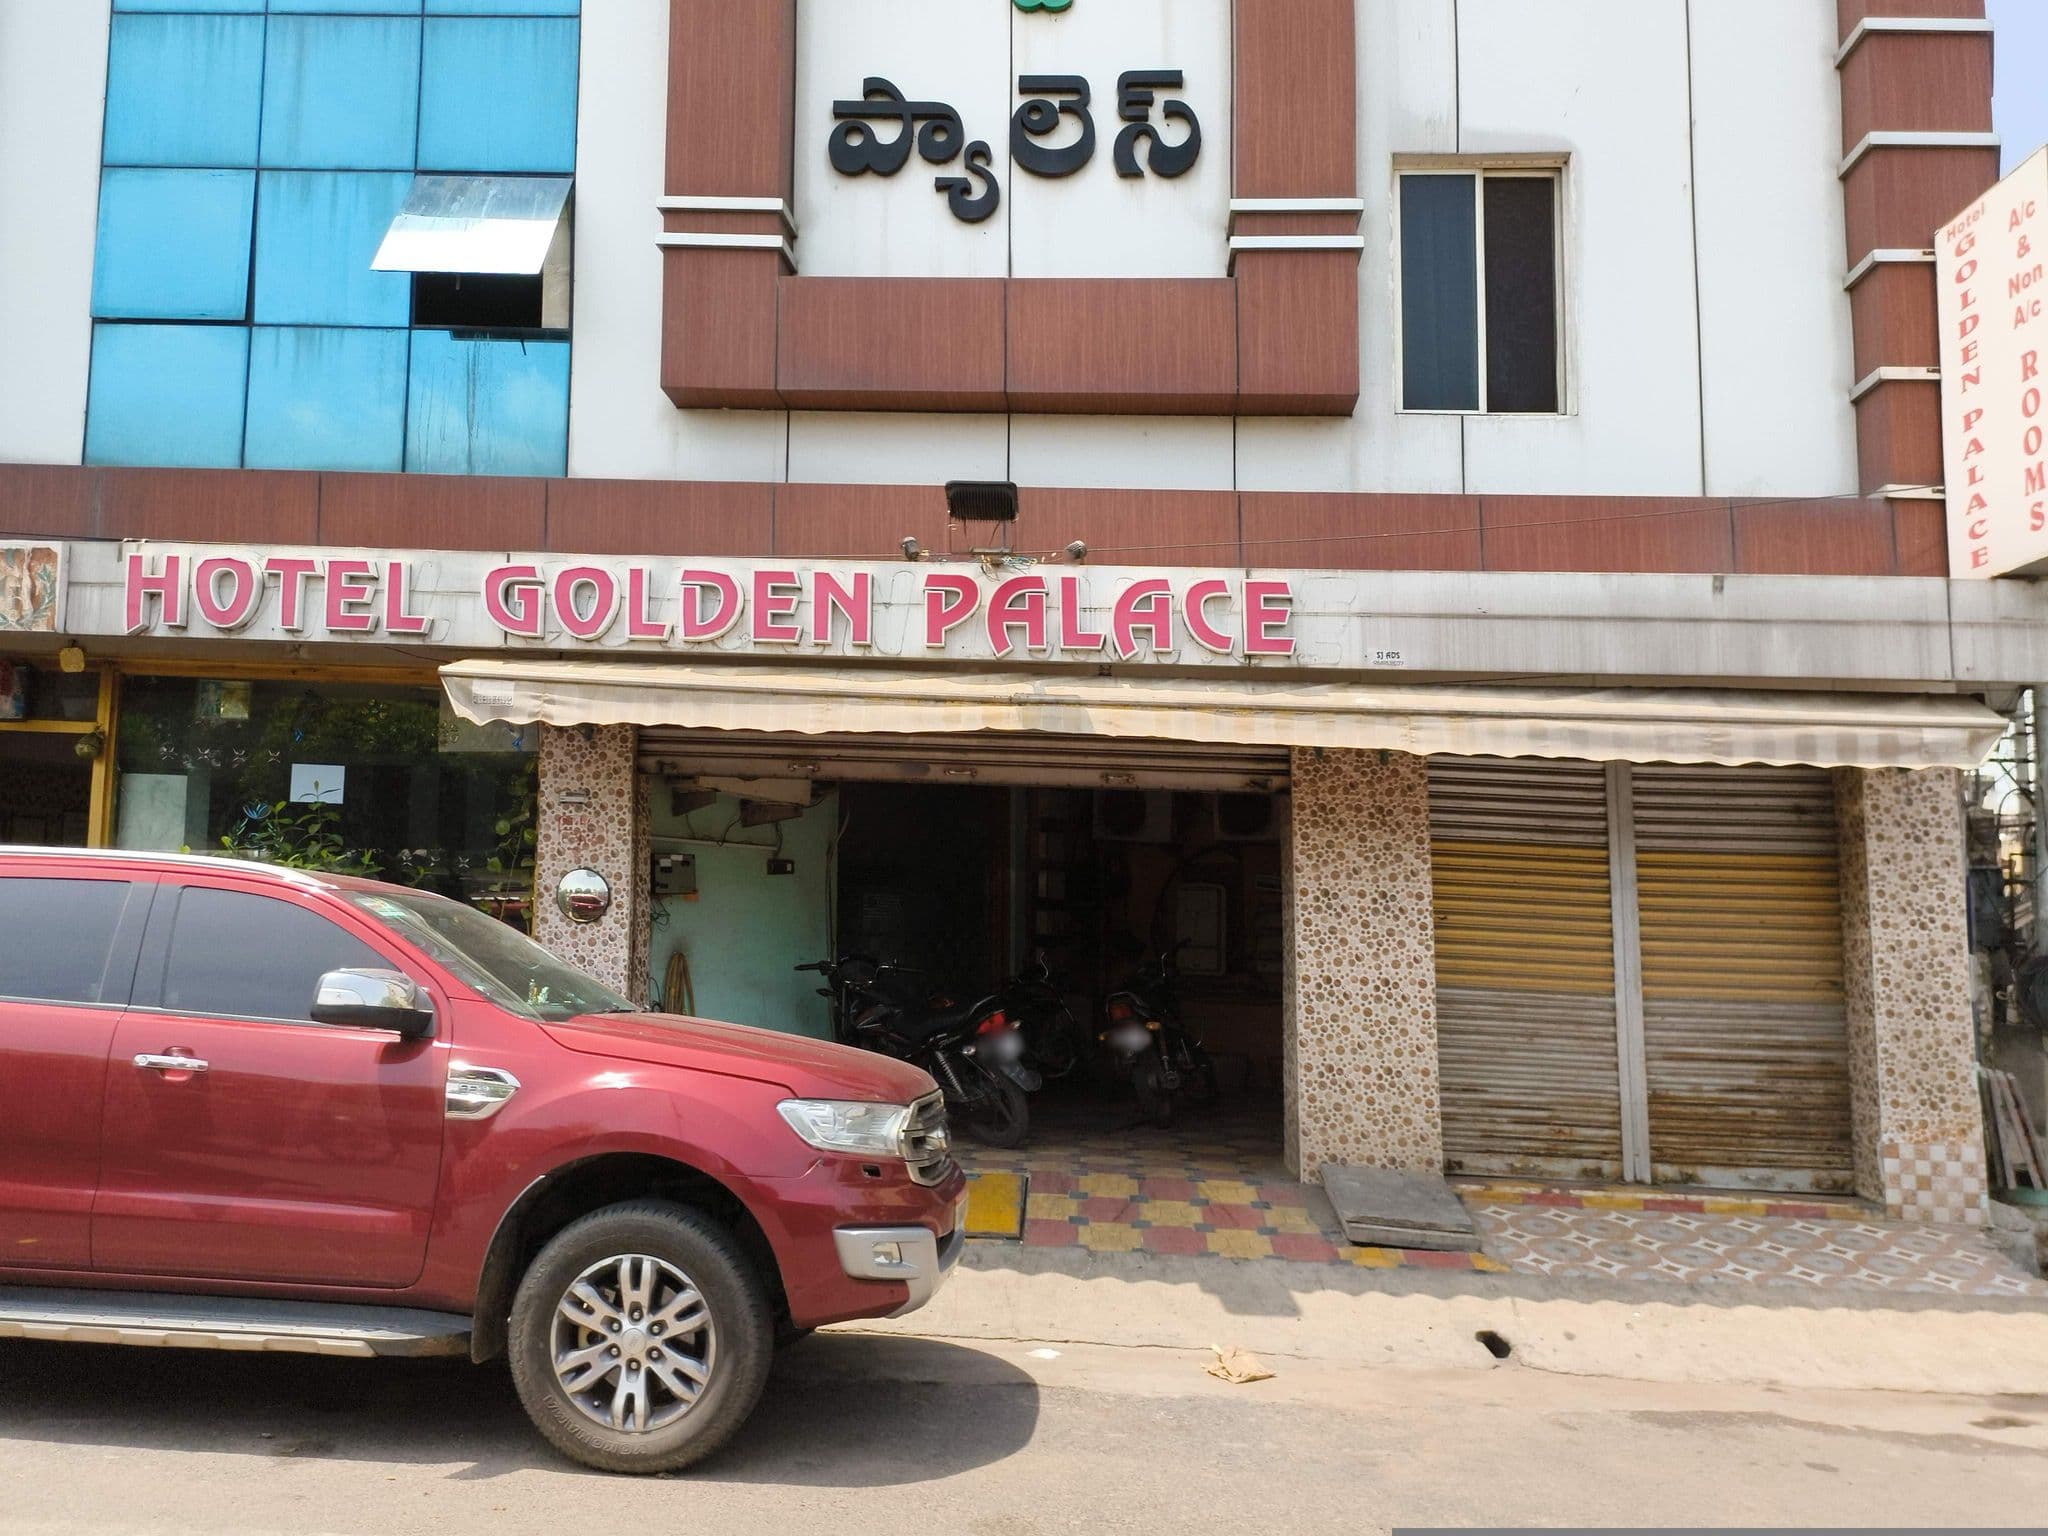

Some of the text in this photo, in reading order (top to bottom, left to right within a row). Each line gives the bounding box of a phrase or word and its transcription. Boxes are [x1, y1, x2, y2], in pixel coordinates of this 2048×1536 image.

[828, 69, 1201, 223] ప్యాలెస్
[1946, 201, 1985, 243] Hotel
[2016, 234, 2031, 259] &
[2007, 263, 2043, 300] Non
[1954, 231, 1990, 570] GOLDEN PALACE
[2020, 349, 2047, 532] ROOMS
[124, 552, 1297, 661] HOTEL GOLDEN PALACE
